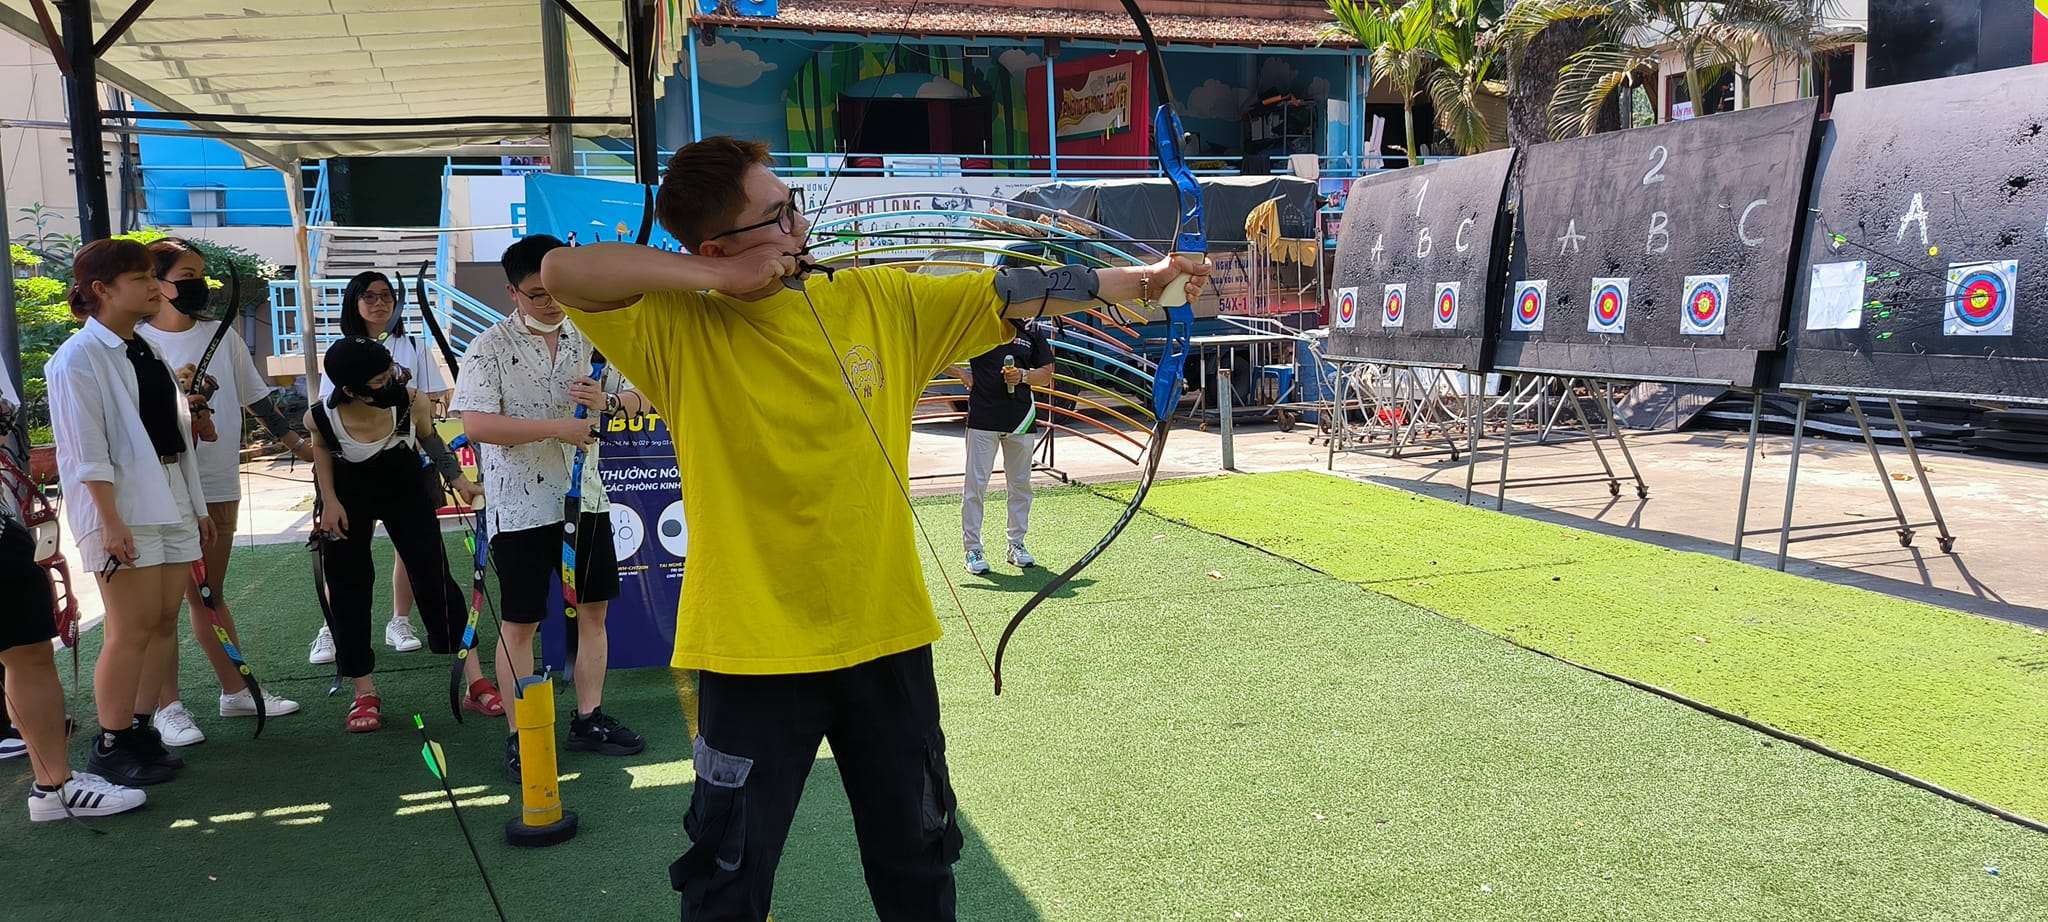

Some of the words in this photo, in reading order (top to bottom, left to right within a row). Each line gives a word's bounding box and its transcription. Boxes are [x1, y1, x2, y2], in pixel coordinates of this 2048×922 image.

[1643, 146, 1668, 184] 2
[884, 200, 920, 215] LONG
[1415, 178, 1429, 217] 1
[1557, 219, 1586, 255] A
[1646, 211, 1669, 254] B
[1738, 199, 1768, 246] C
[1897, 192, 1929, 244] A
[1371, 234, 1385, 264] A
[1417, 227, 1433, 258] B
[1456, 217, 1475, 252] C
[1050, 271, 1076, 290] 22
[600, 466, 658, 480] THƯỞNG
[660, 465, 681, 479] NÓ
[603, 482, 624, 492] CÁC
[625, 481, 658, 491] PHÒNG
